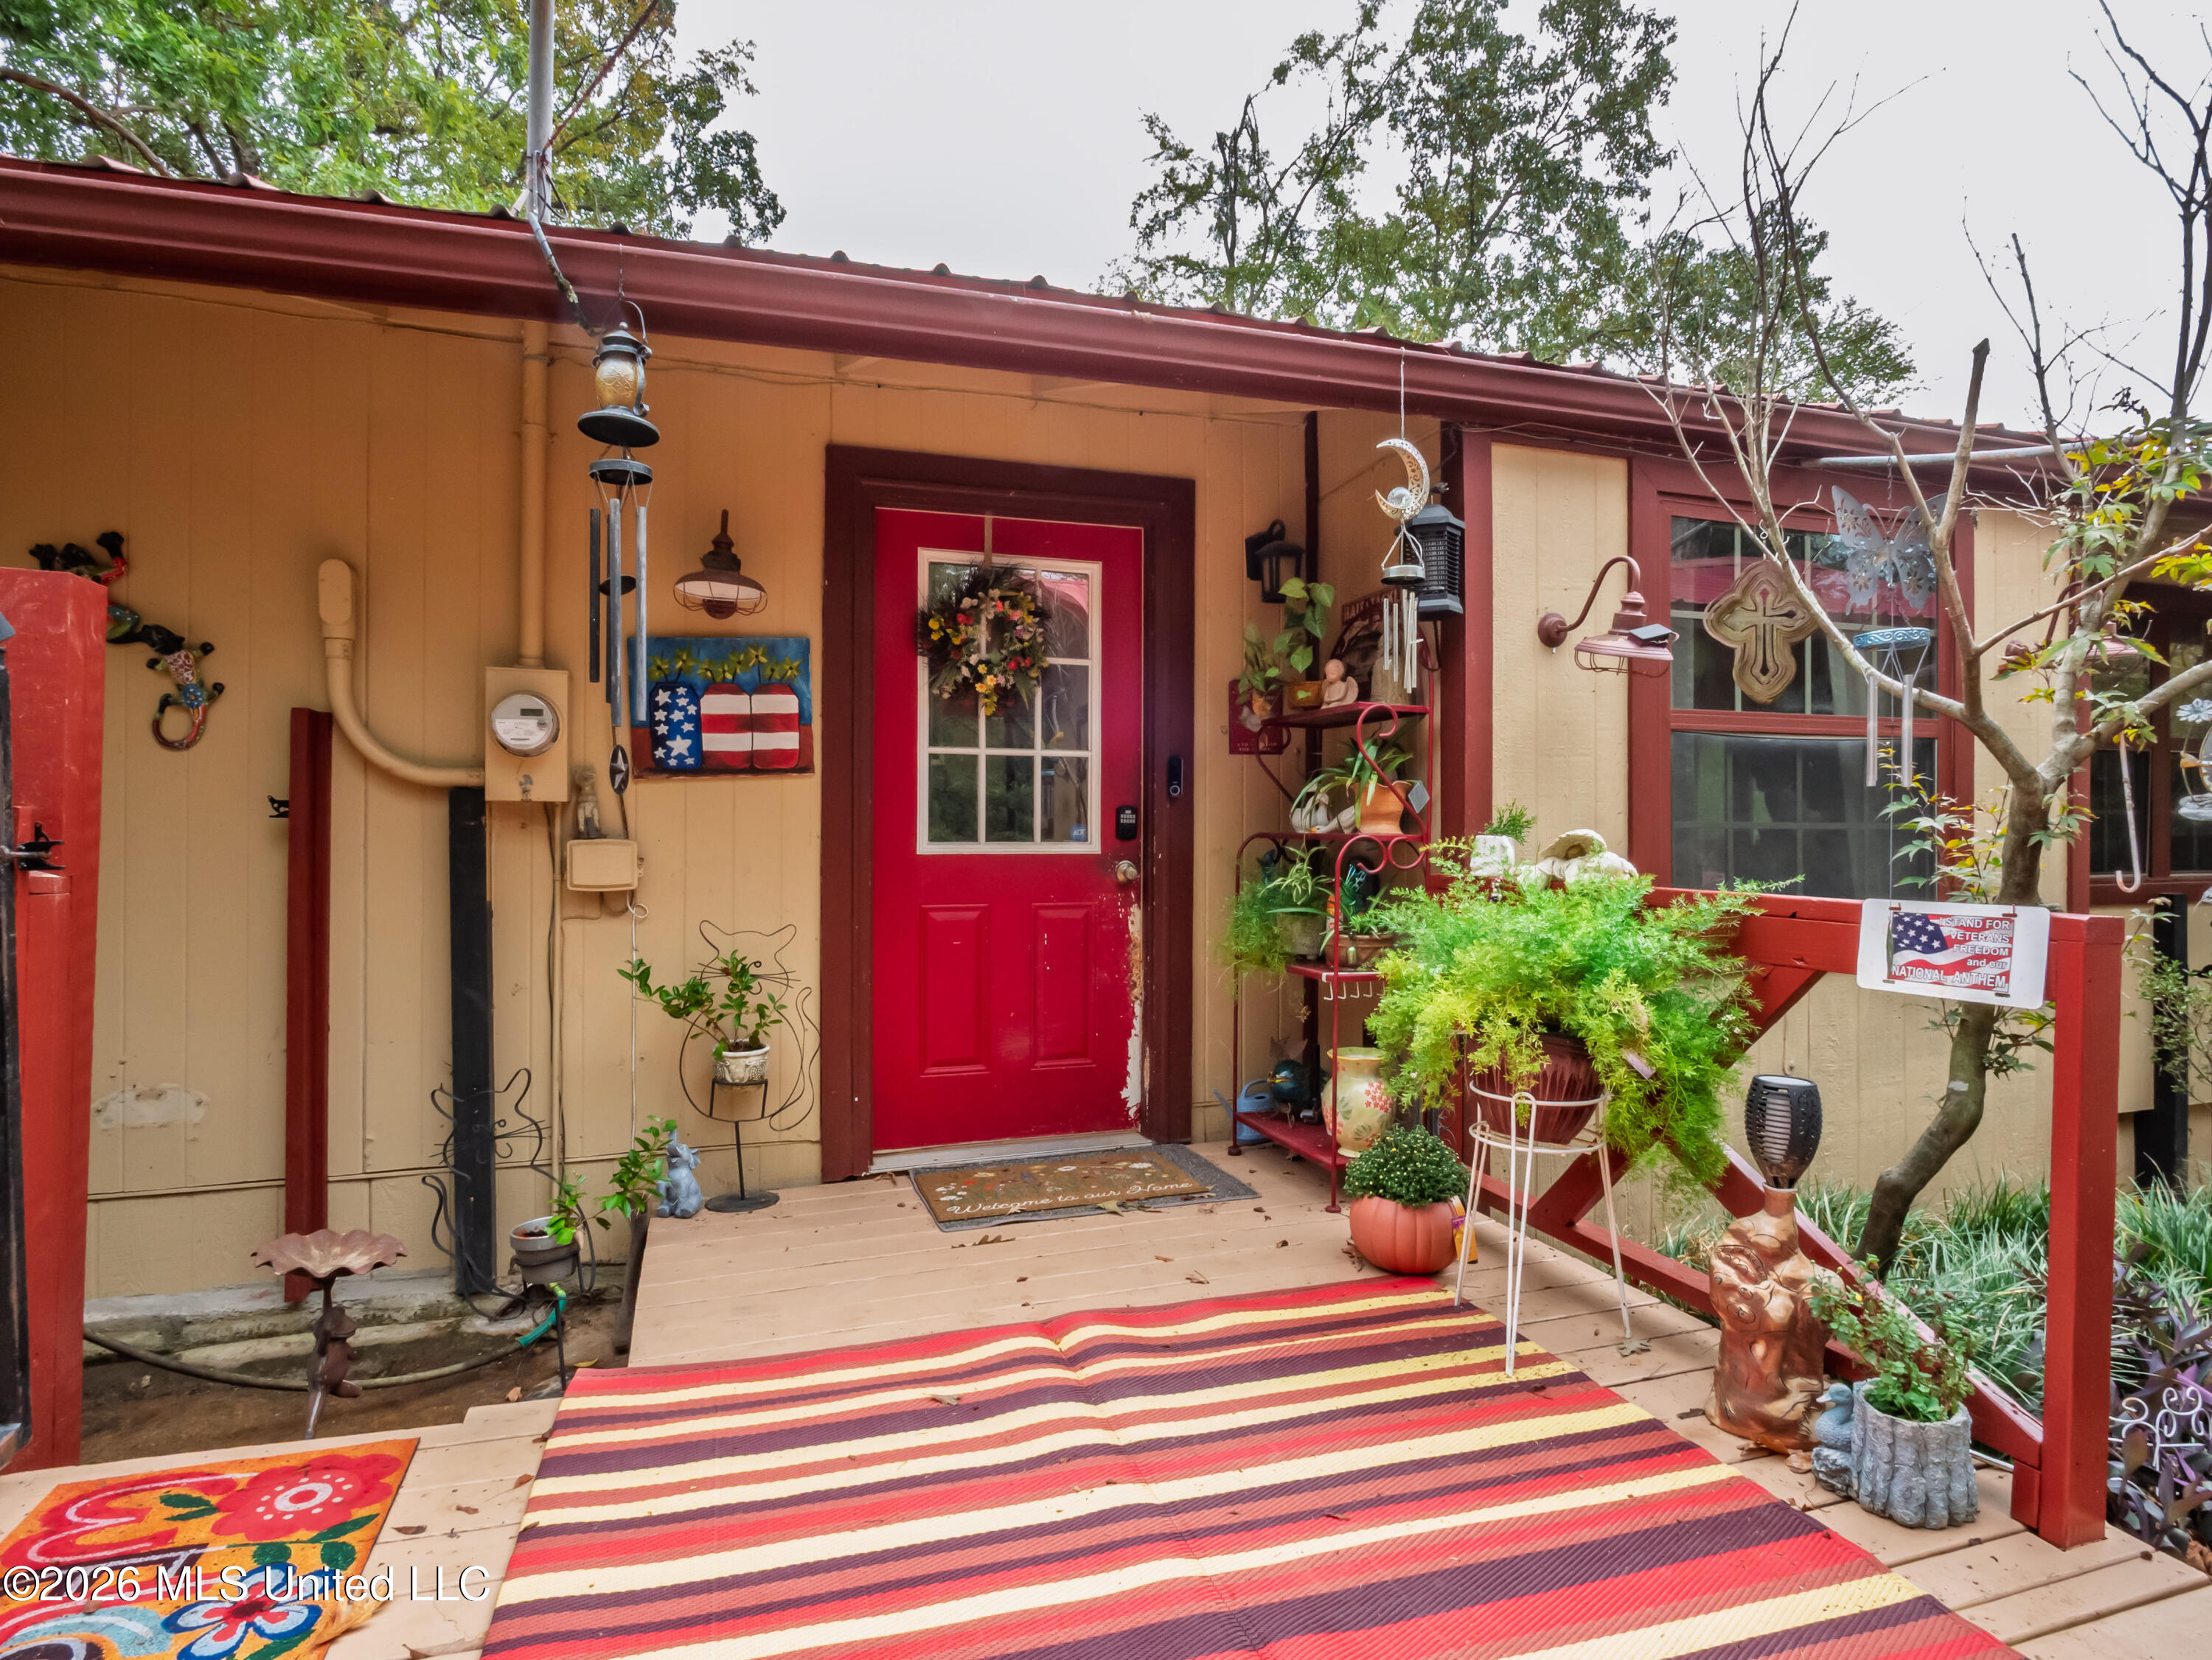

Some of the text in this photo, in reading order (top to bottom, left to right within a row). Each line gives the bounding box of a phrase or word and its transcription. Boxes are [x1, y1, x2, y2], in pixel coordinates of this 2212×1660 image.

[1945, 917, 1983, 929] STAND
[1986, 919, 2011, 930] FOR
[1950, 930, 2010, 944] VETERANS
[1953, 944, 2009, 956] FREEDOM
[1966, 958, 2008, 969] and our
[1891, 965, 2006, 988] NATIONAL ANTHEM
[946, 1198, 1053, 1215] Welcome
[1084, 1190, 1121, 1199] our
